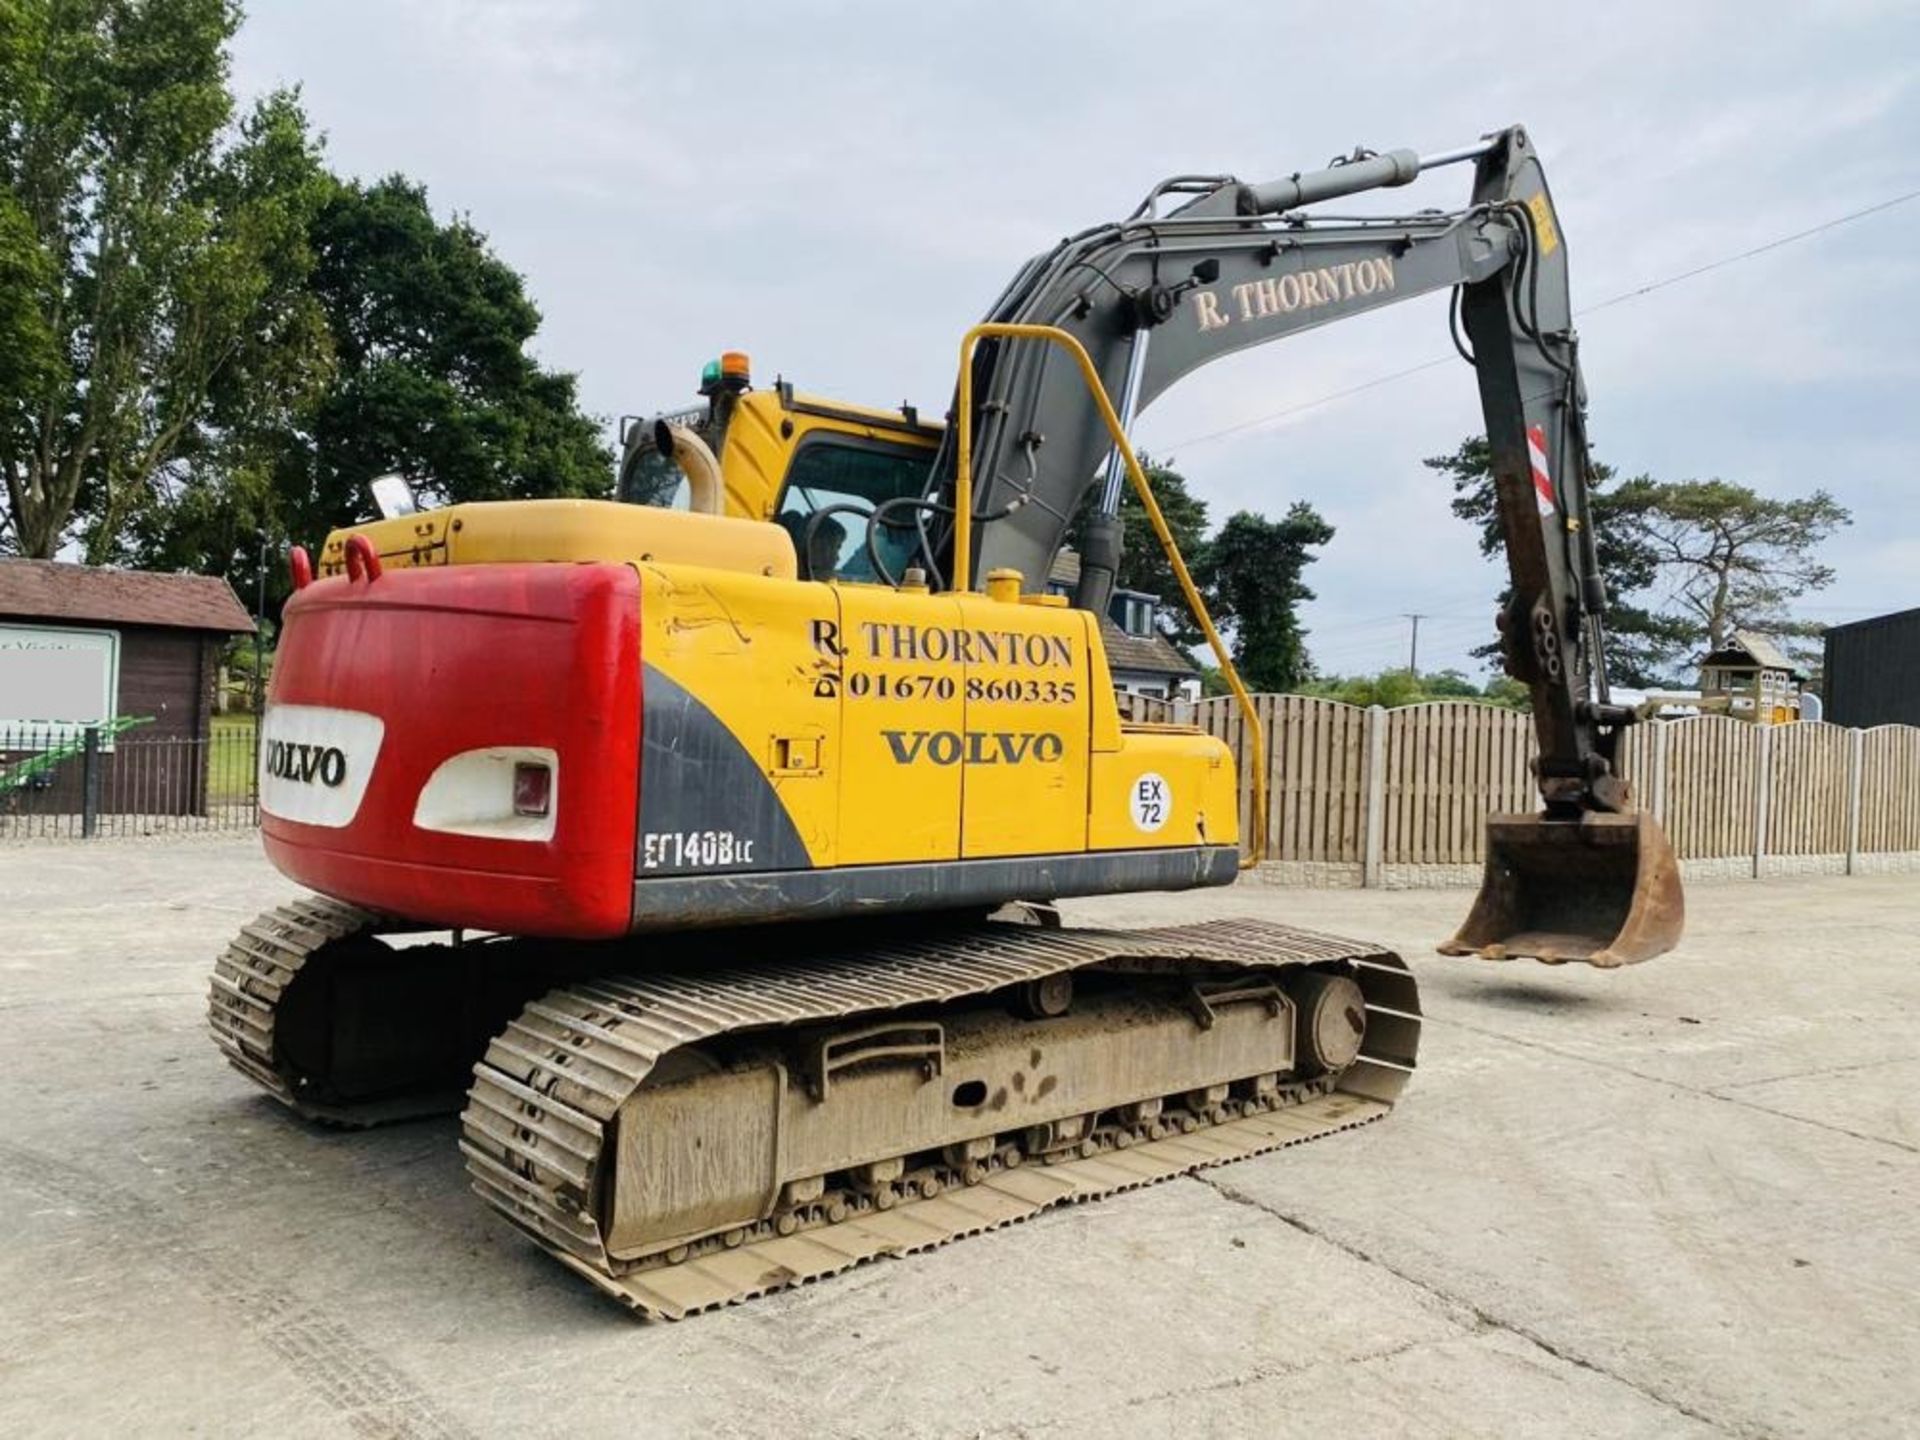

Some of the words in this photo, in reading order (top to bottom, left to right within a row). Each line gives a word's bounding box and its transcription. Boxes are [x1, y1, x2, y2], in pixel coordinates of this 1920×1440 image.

[1193, 290, 1230, 332] R.
[1231, 255, 1396, 322] THORNTON
[862, 621, 1073, 668] THORNTON
[849, 672, 956, 699] 01670
[965, 678, 1077, 704] 860335
[266, 738, 347, 787] VOLVO
[880, 730, 1064, 766] VOLVO
[1139, 780, 1162, 801] EX
[1140, 803, 1161, 823] 72
